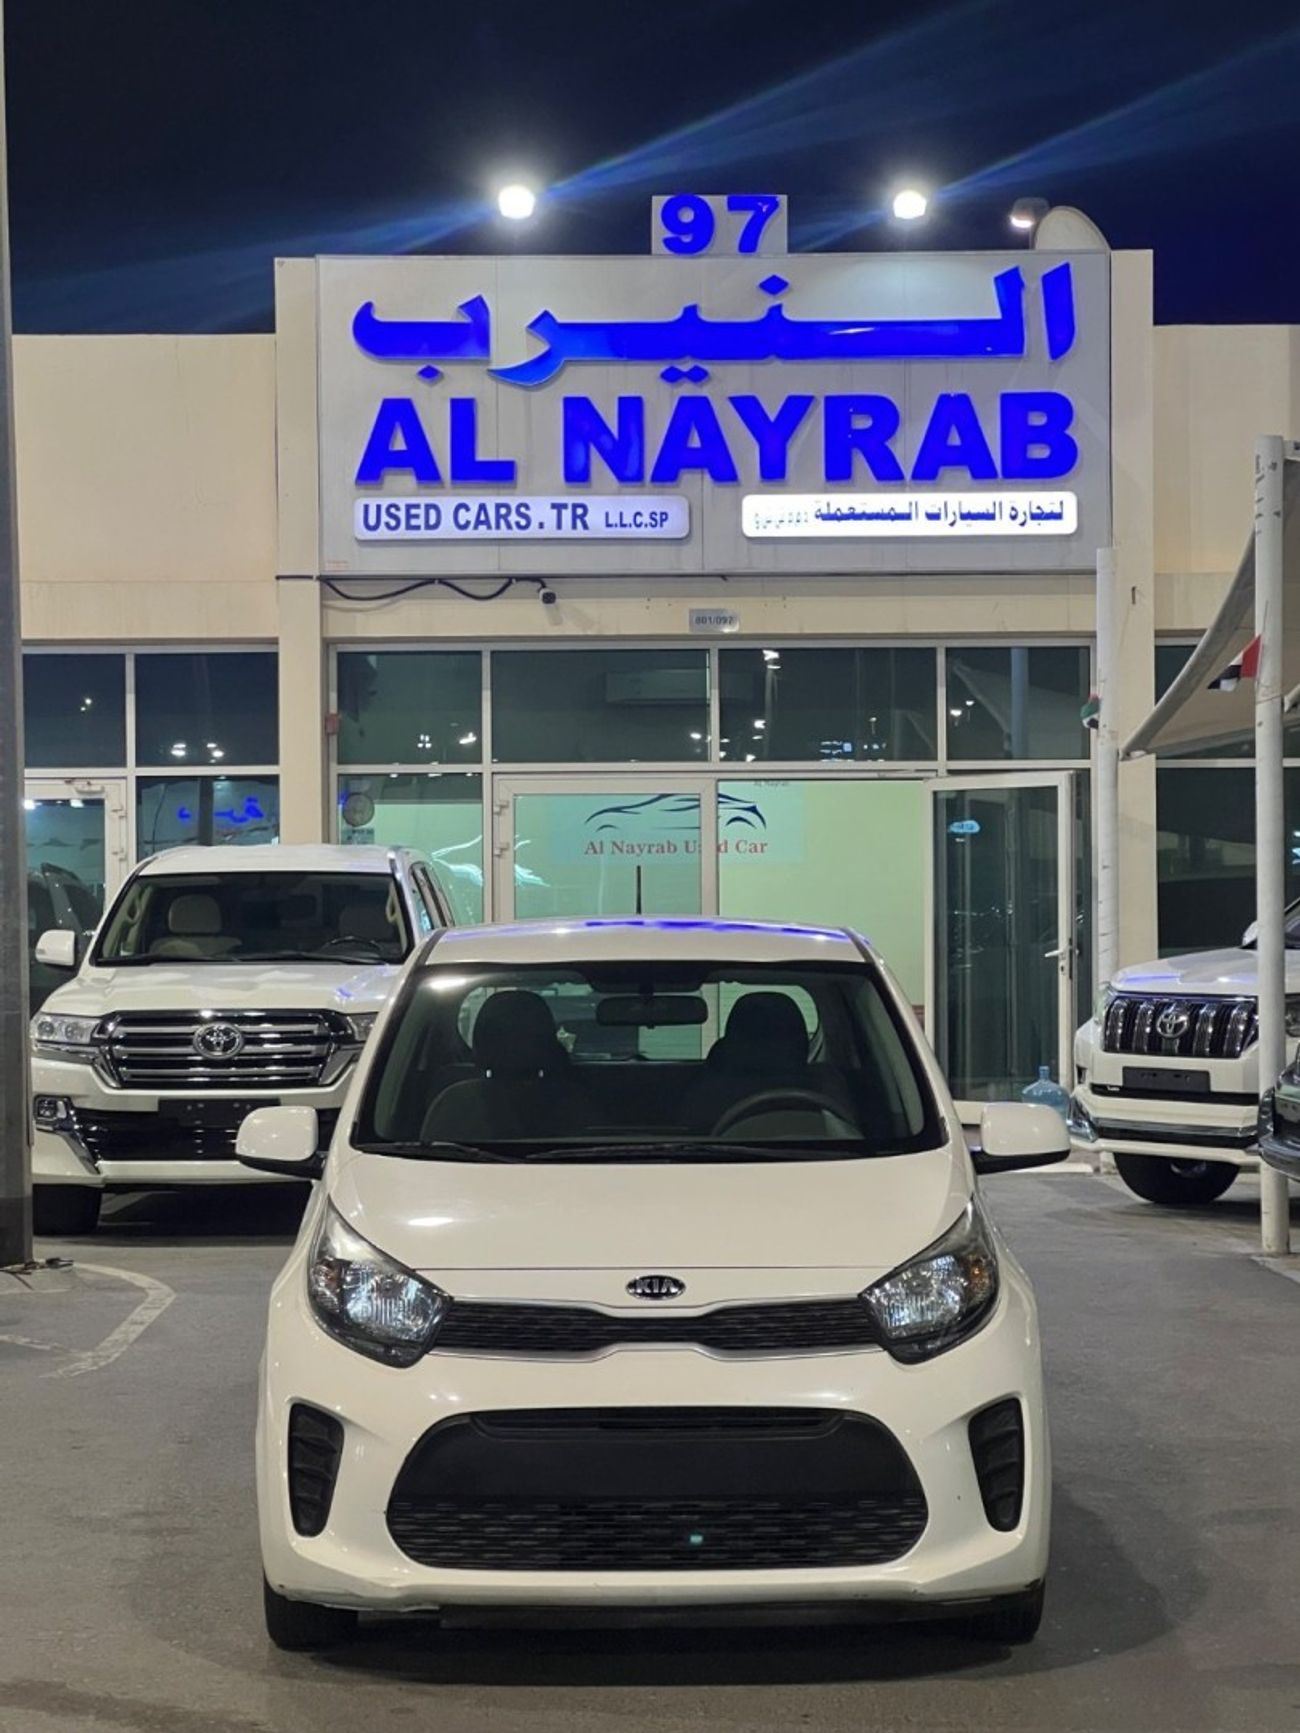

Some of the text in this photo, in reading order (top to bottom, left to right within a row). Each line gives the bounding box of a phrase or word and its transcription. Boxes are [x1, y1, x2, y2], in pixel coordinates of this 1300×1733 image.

[660, 194, 780, 256] 97
[352, 262, 1076, 388] النيرب
[355, 391, 1079, 486] AL NAYRAB
[363, 503, 442, 531] USED
[584, 839, 768, 856] Al Nayrab Ud Car
[634, 1278, 681, 1295] KIA
